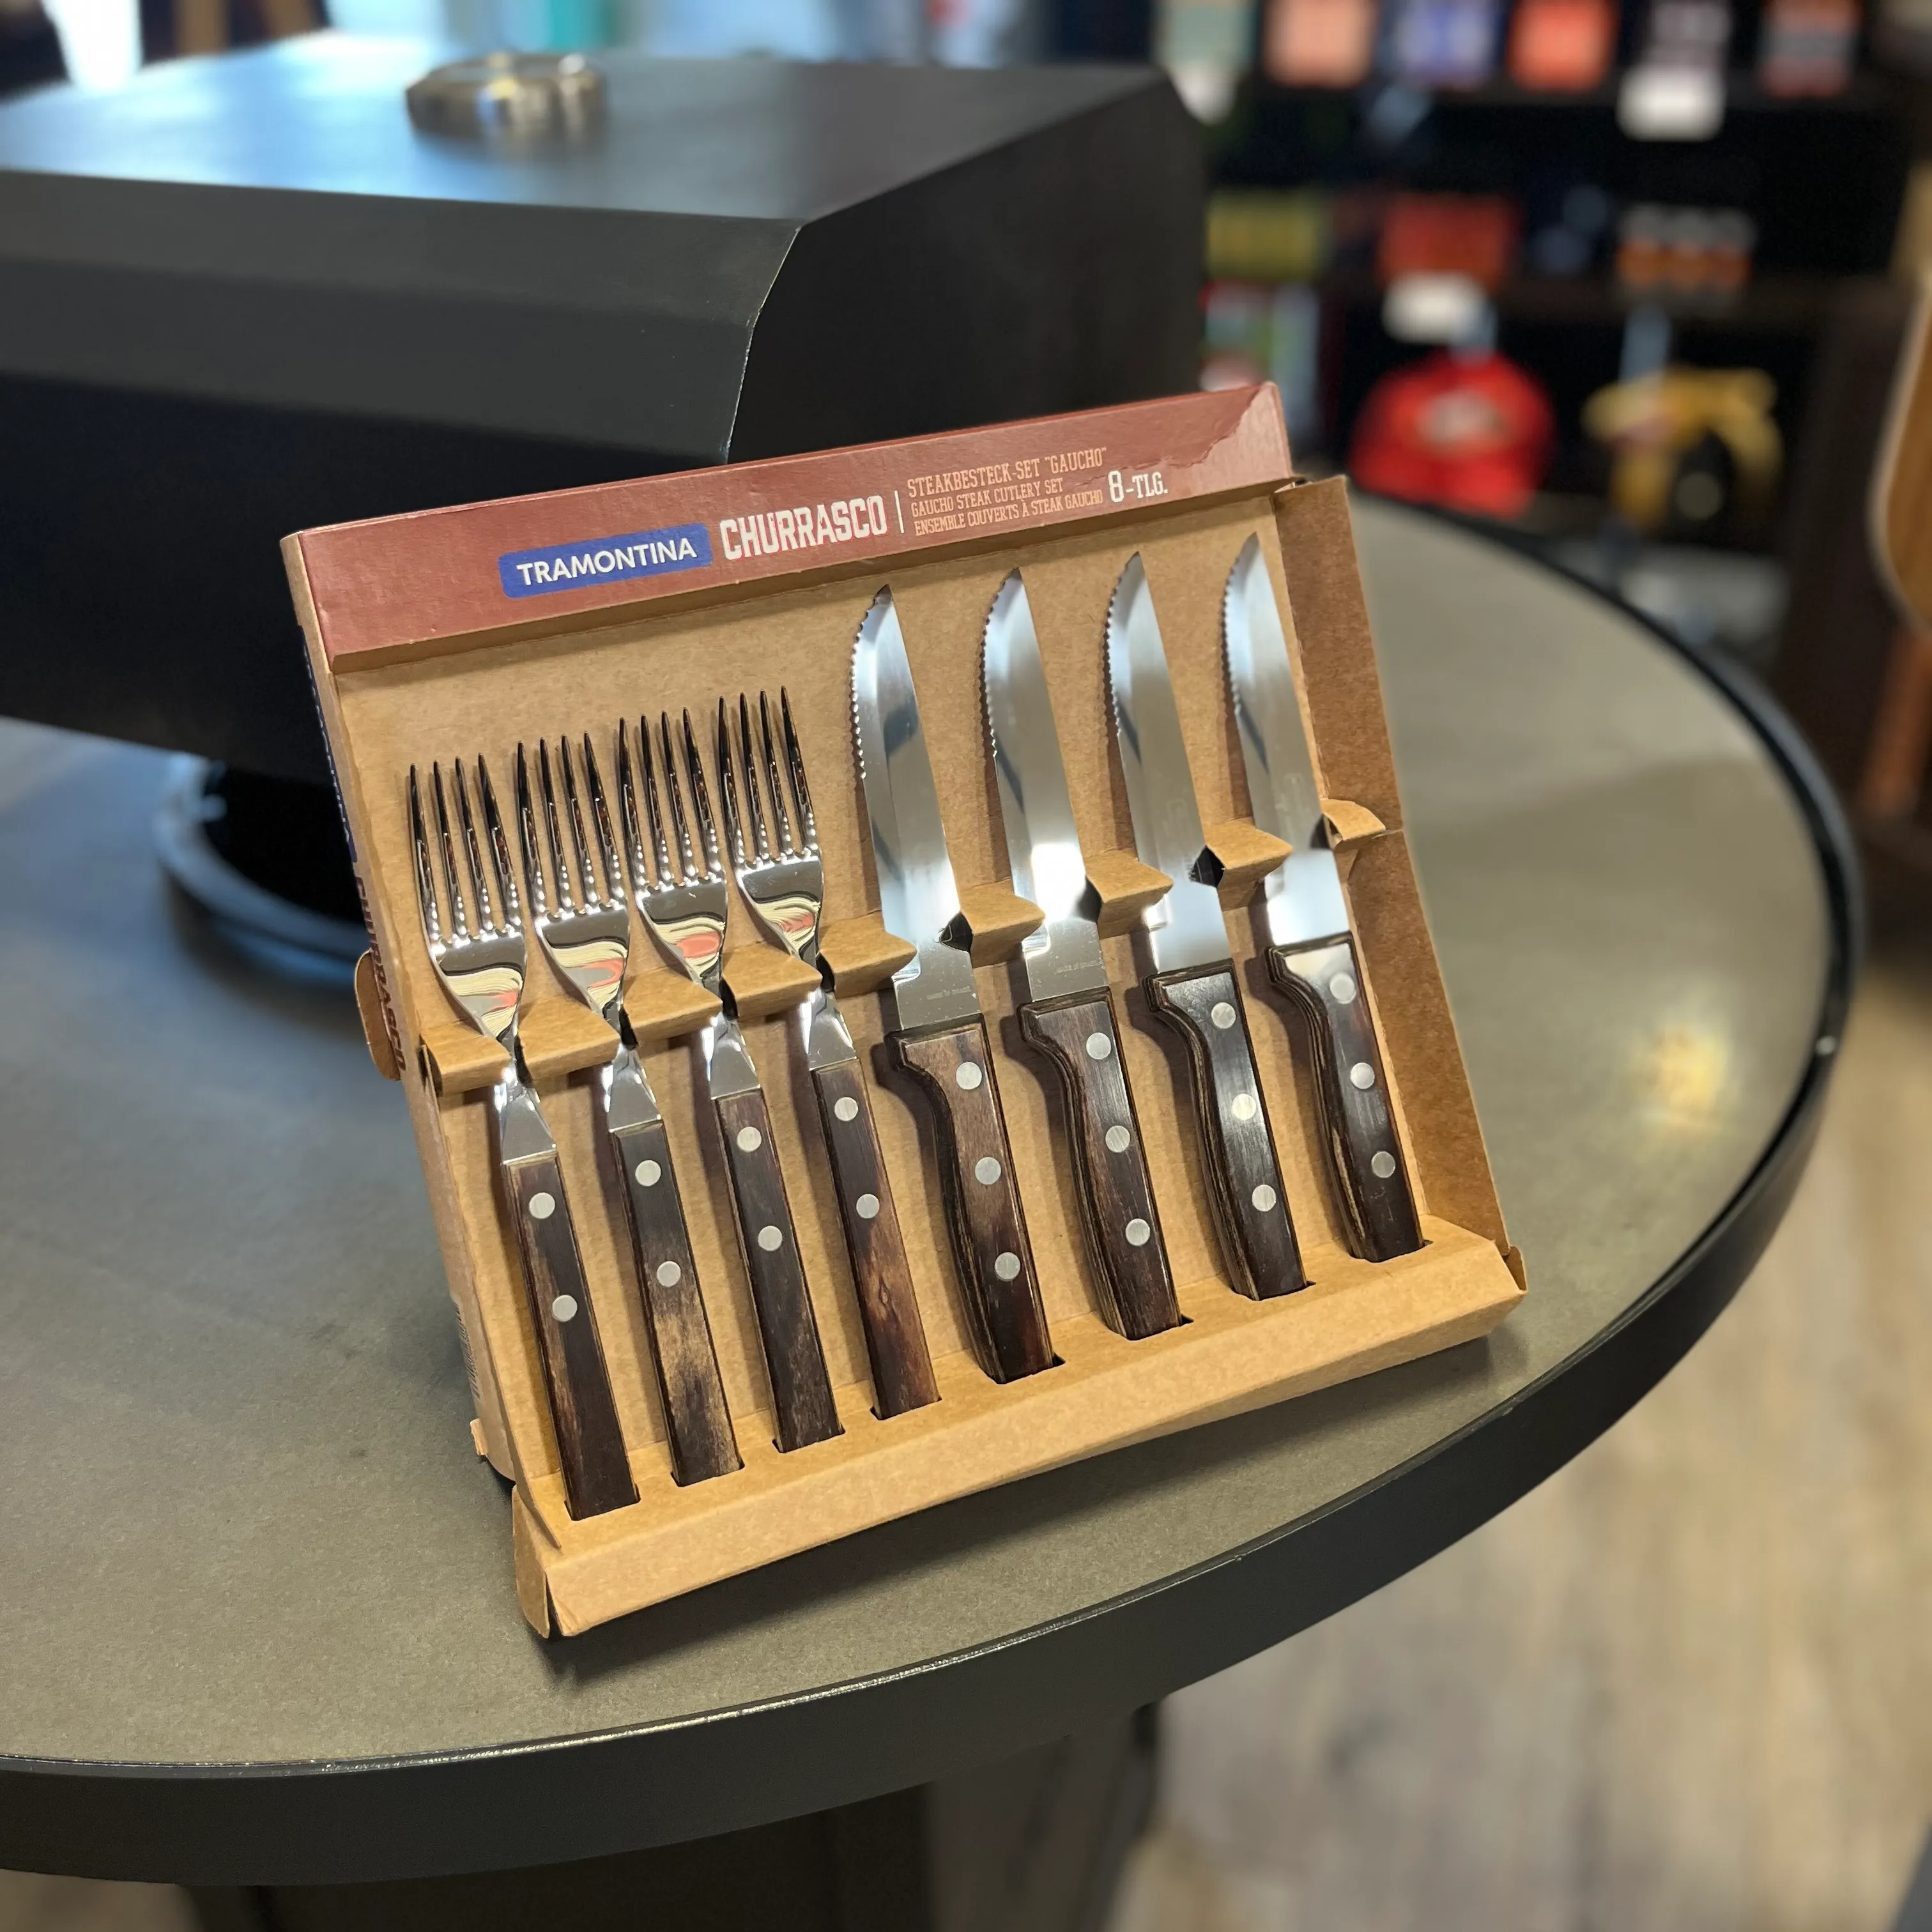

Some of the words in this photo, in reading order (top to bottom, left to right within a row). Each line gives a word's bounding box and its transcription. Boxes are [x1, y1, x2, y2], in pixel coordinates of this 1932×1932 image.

[907, 458, 1040, 498] STEAKBESTECK-SET
[1045, 447, 1107, 473] "GAUCHO"
[1108, 470, 1169, 503] 8-TLG.
[911, 496, 954, 517] GAUCHO
[956, 489, 992, 510] STEAK
[994, 480, 1041, 503] CUTLERY
[1045, 477, 1064, 495] SET
[914, 513, 966, 536] ENSEMBLE
[967, 503, 1019, 526] COUVERTS
[1031, 496, 1064, 516] STEAK
[1064, 489, 1104, 509] GAUCHO
[516, 537, 698, 586] TRAMONTINA
[719, 494, 889, 562] CHURRASCO
